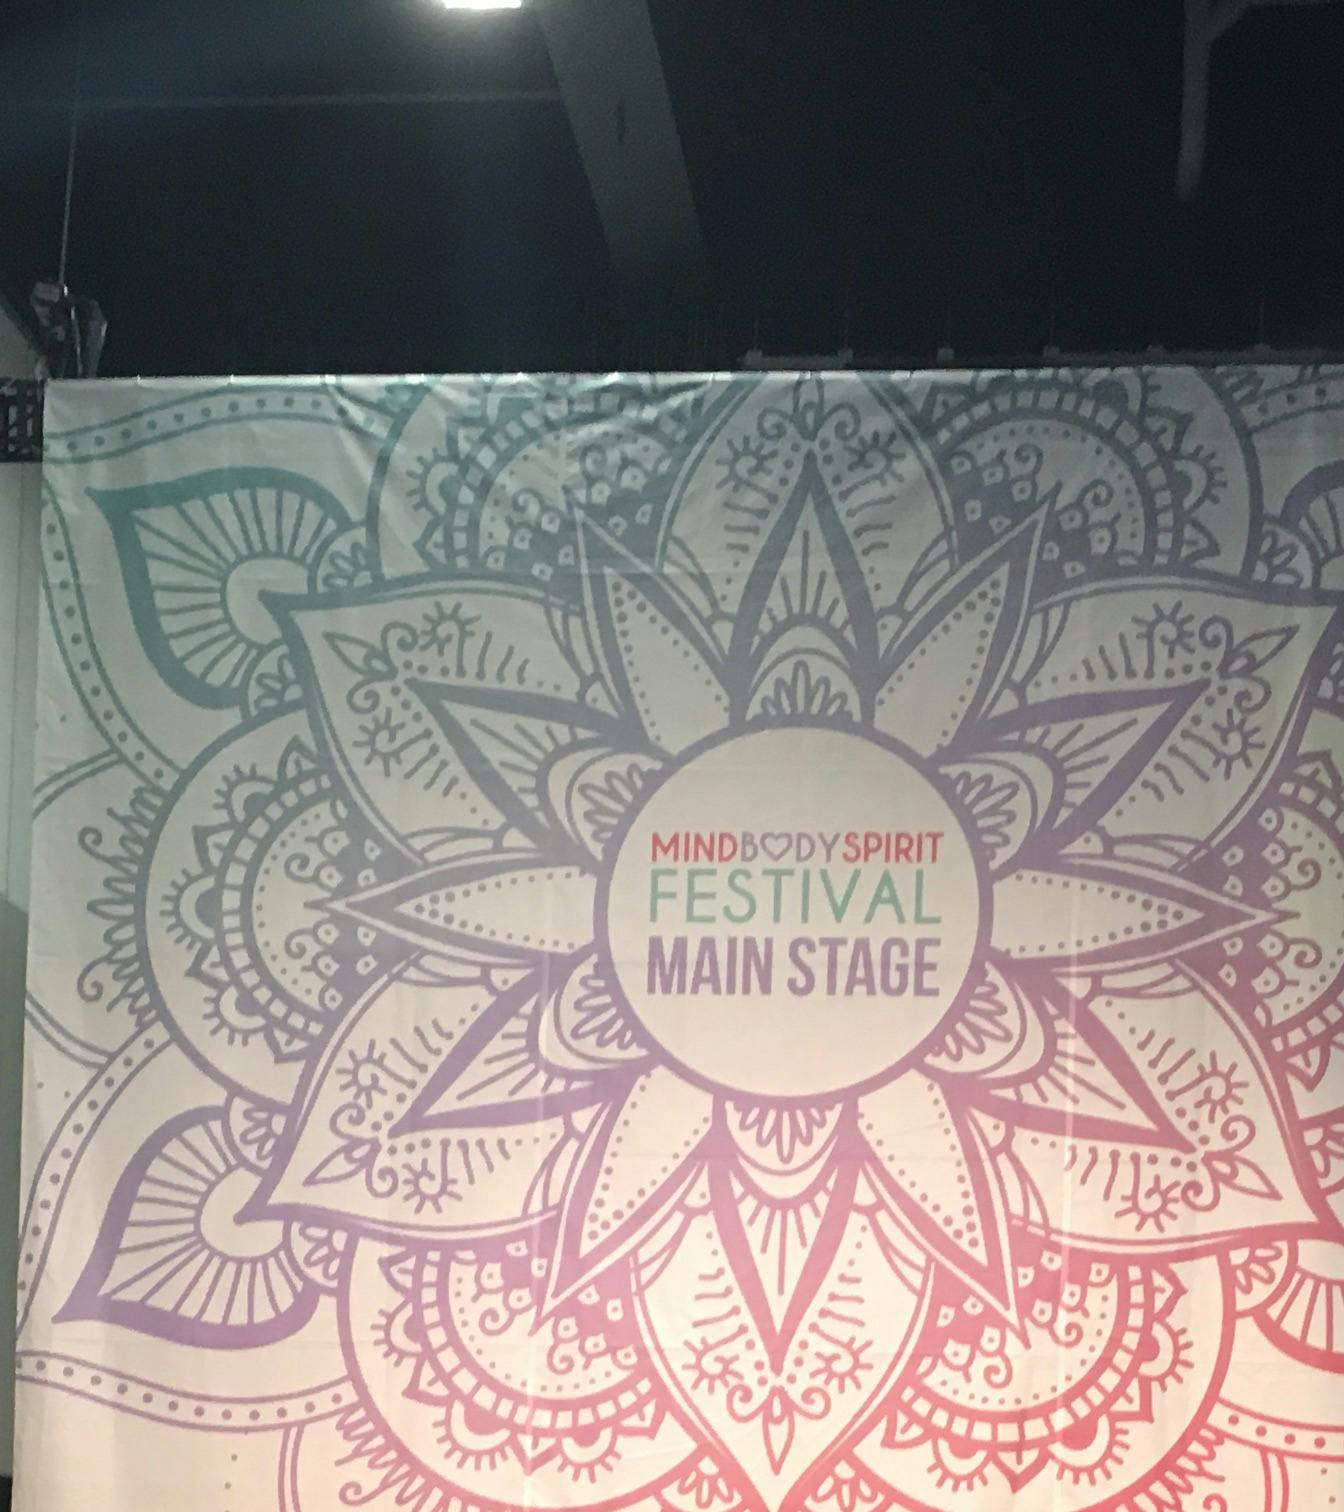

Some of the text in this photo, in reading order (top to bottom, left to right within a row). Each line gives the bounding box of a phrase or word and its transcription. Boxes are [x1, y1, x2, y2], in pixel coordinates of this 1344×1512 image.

[649, 868, 942, 924] FESTIVAL
[647, 936, 941, 997] MAIN STAGE
